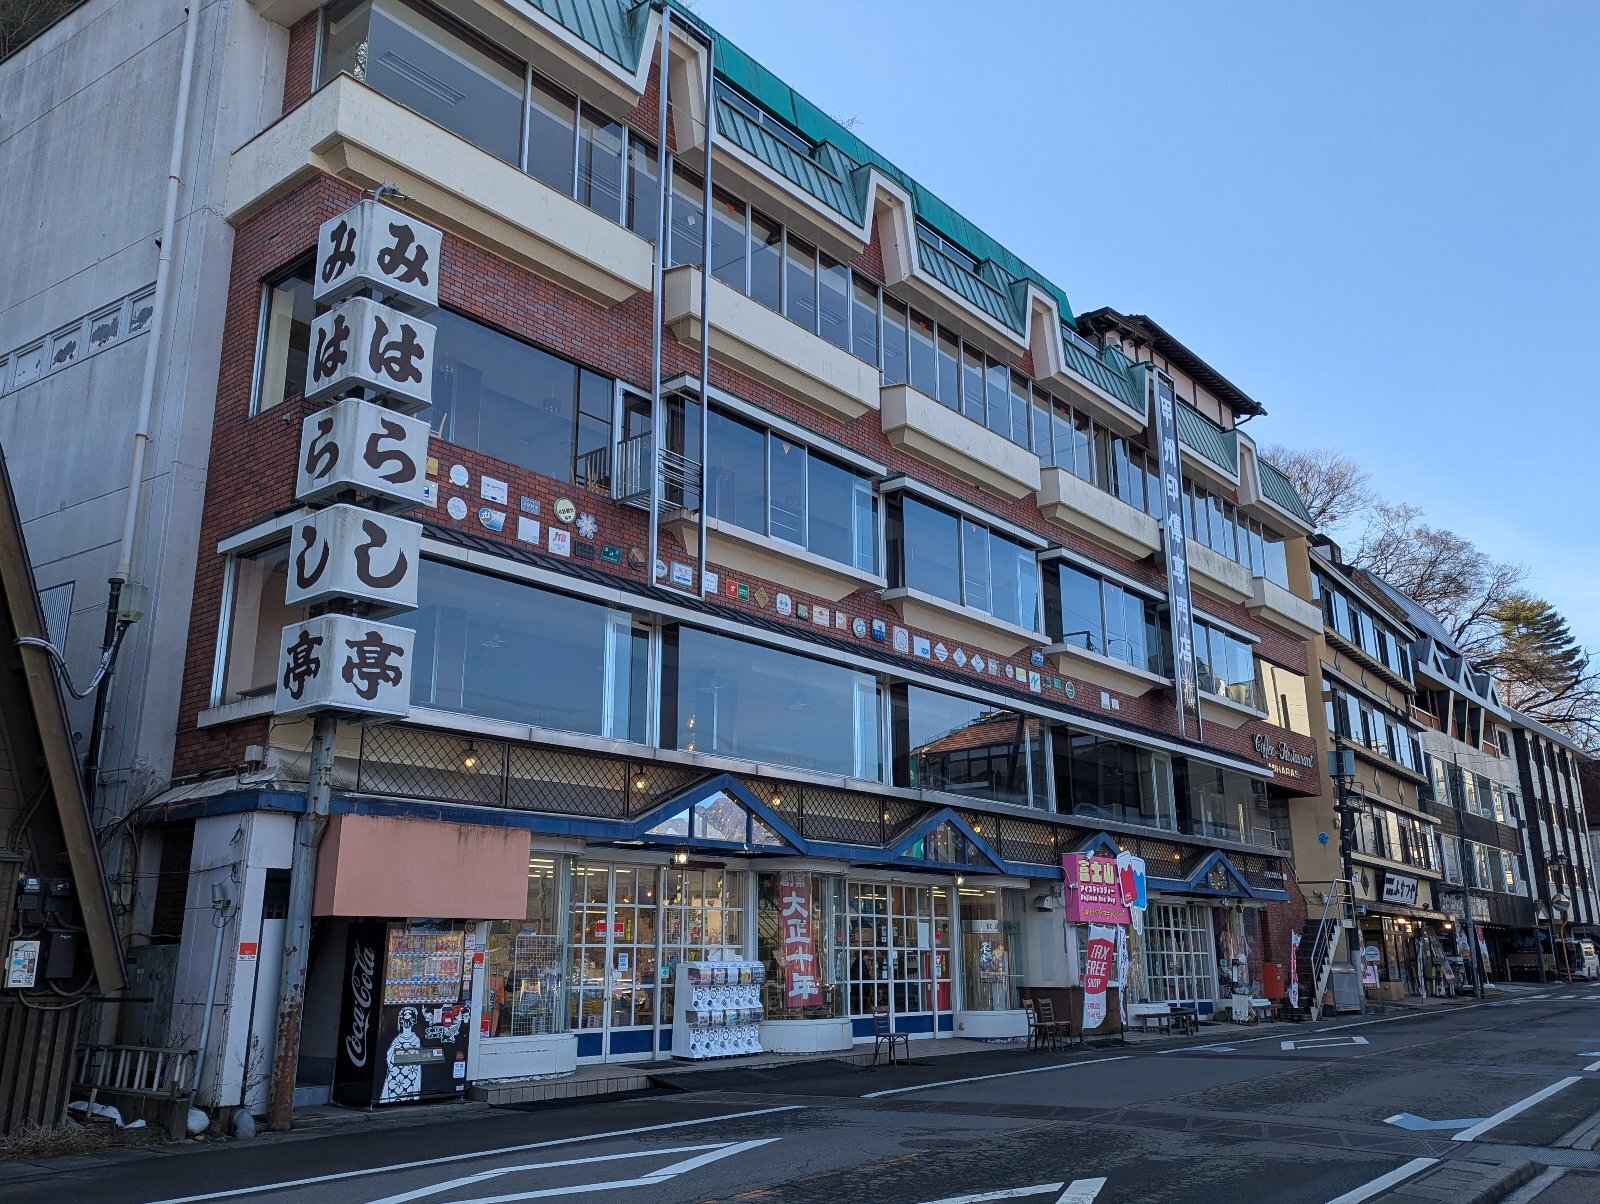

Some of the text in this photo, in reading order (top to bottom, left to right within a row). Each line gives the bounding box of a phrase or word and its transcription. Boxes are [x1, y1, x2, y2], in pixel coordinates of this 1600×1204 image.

[283, 219, 358, 700] みはらし亭
[341, 221, 429, 701] みはらし亭
[1078, 859, 1115, 885] 富士山
[782, 891, 819, 1000] 大正十年
[1086, 960, 1108, 977] FREE
[1090, 944, 1111, 961] TAX
[346, 937, 376, 1068] Coca-Cola
[1087, 978, 1101, 988] SHOP
